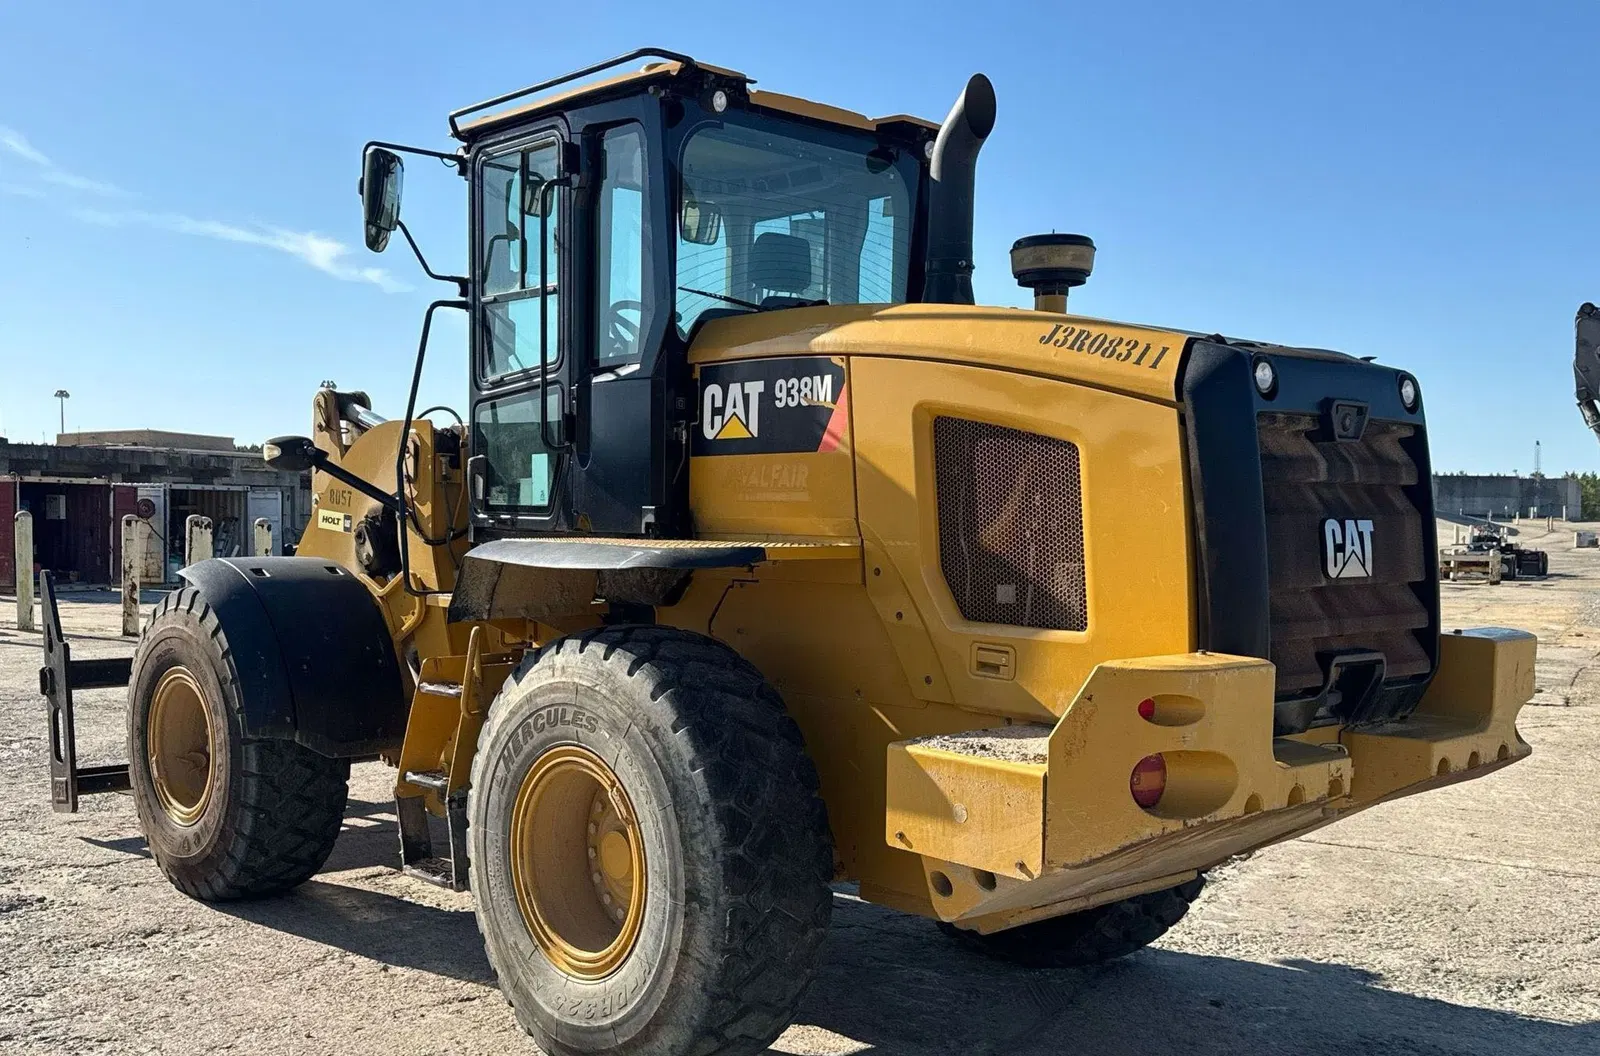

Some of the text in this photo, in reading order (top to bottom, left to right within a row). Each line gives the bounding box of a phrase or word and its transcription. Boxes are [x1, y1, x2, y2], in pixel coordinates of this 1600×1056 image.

[1039, 324, 1170, 369] J3R08311
[702, 380, 765, 440] CAT
[774, 374, 833, 409] 938M
[321, 515, 342, 526] HOLT
[329, 488, 353, 508] 8057
[1324, 518, 1375, 579] CAT
[501, 707, 599, 774] HERCULES
